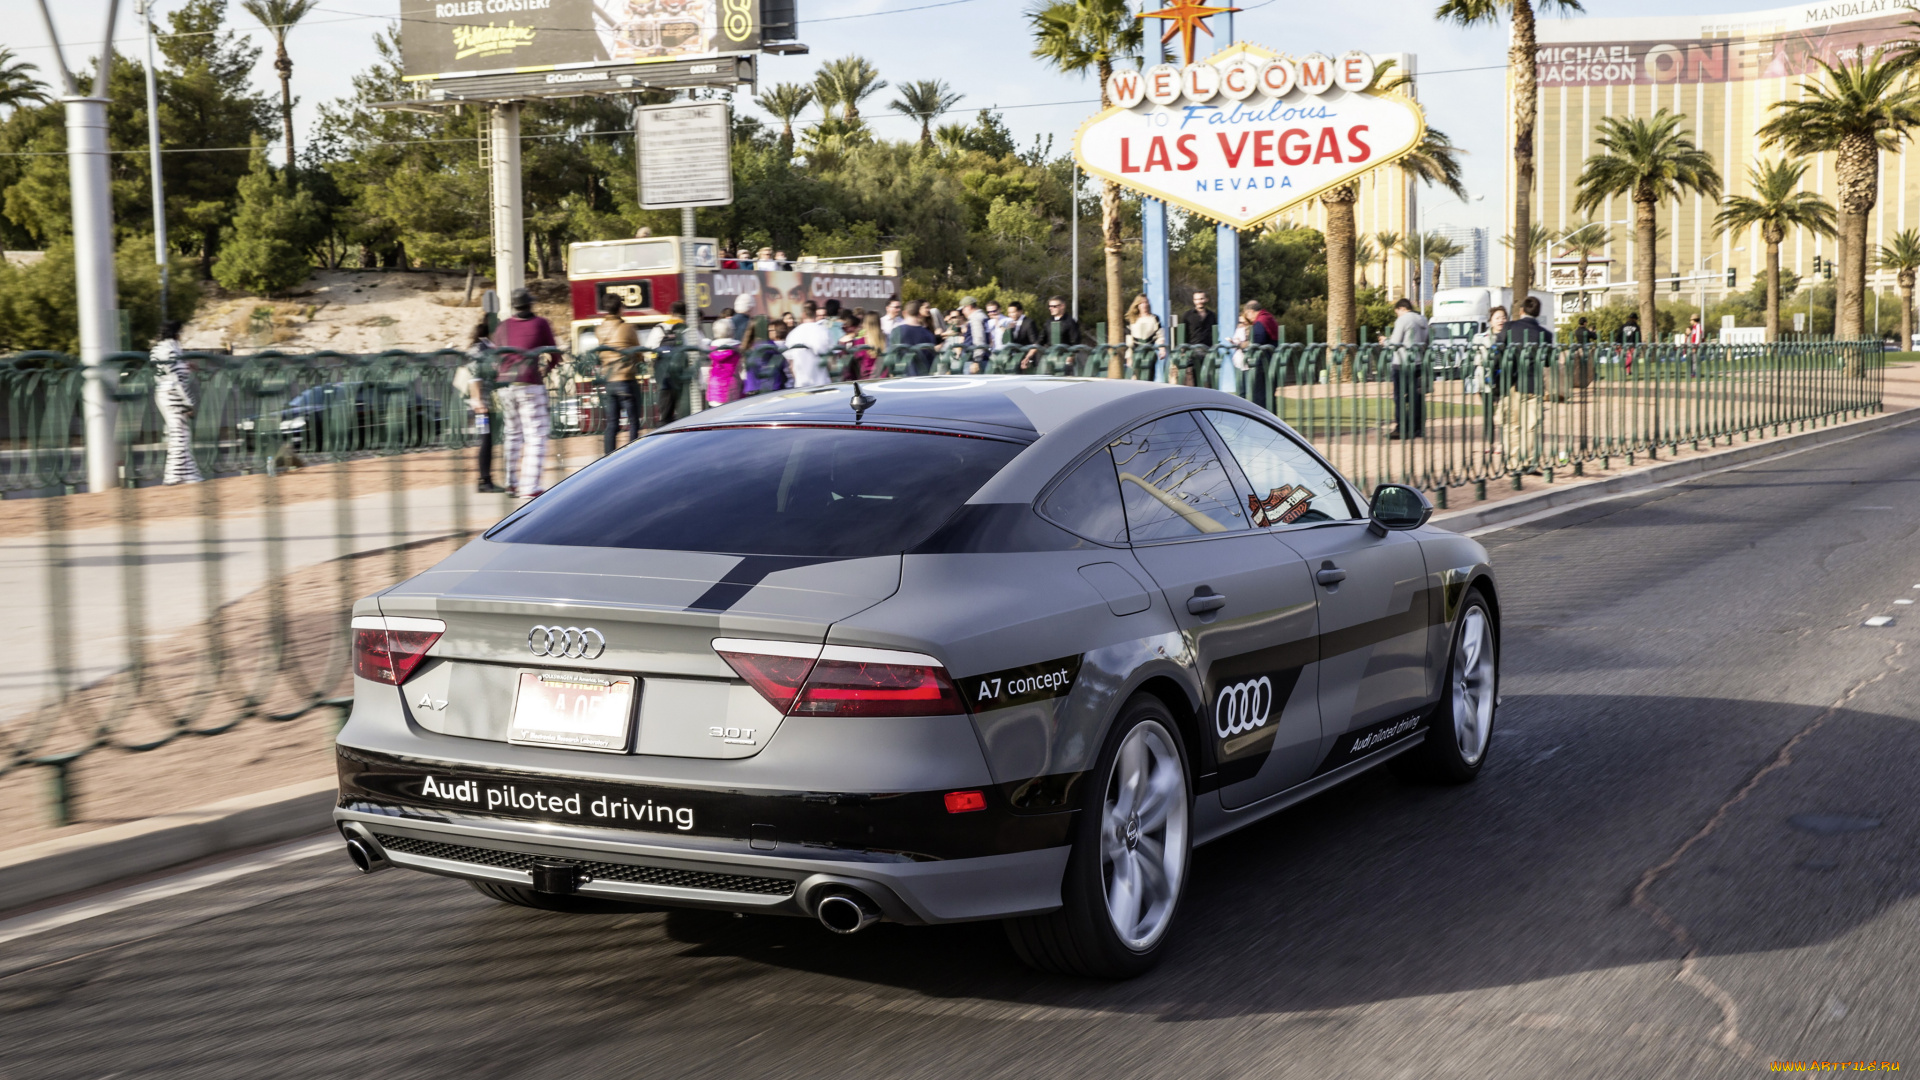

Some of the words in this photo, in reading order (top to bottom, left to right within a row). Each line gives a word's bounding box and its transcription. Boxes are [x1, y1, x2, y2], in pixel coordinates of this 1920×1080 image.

[436, 1, 484, 18] ROLLER
[1806, 0, 1886, 22] MANDALAY
[1536, 46, 1637, 65] MICHAEL
[1644, 43, 1759, 81] ONE
[1113, 58, 1362, 100] WELCOME
[1536, 64, 1636, 82] JACKSON
[1143, 112, 1169, 128] TO
[1180, 100, 1337, 130] Fabulous
[1121, 134, 1198, 173] LAS
[1216, 125, 1371, 169] VEGAS
[1196, 175, 1292, 192] NEVADA
[713, 274, 760, 296] DAVID
[811, 277, 895, 299] COPPERFIELD
[978, 678, 1002, 701] A7
[1007, 667, 1070, 695] concept
[417, 693, 449, 711] A7
[557, 734, 580, 743] Research
[580, 736, 609, 747] Laboratory
[1349, 732, 1373, 754] Audi
[1368, 721, 1399, 749] piloted
[1396, 715, 1421, 734] driving
[421, 775, 479, 802] Audi
[487, 785, 581, 814] piloted
[590, 795, 694, 830] driving
